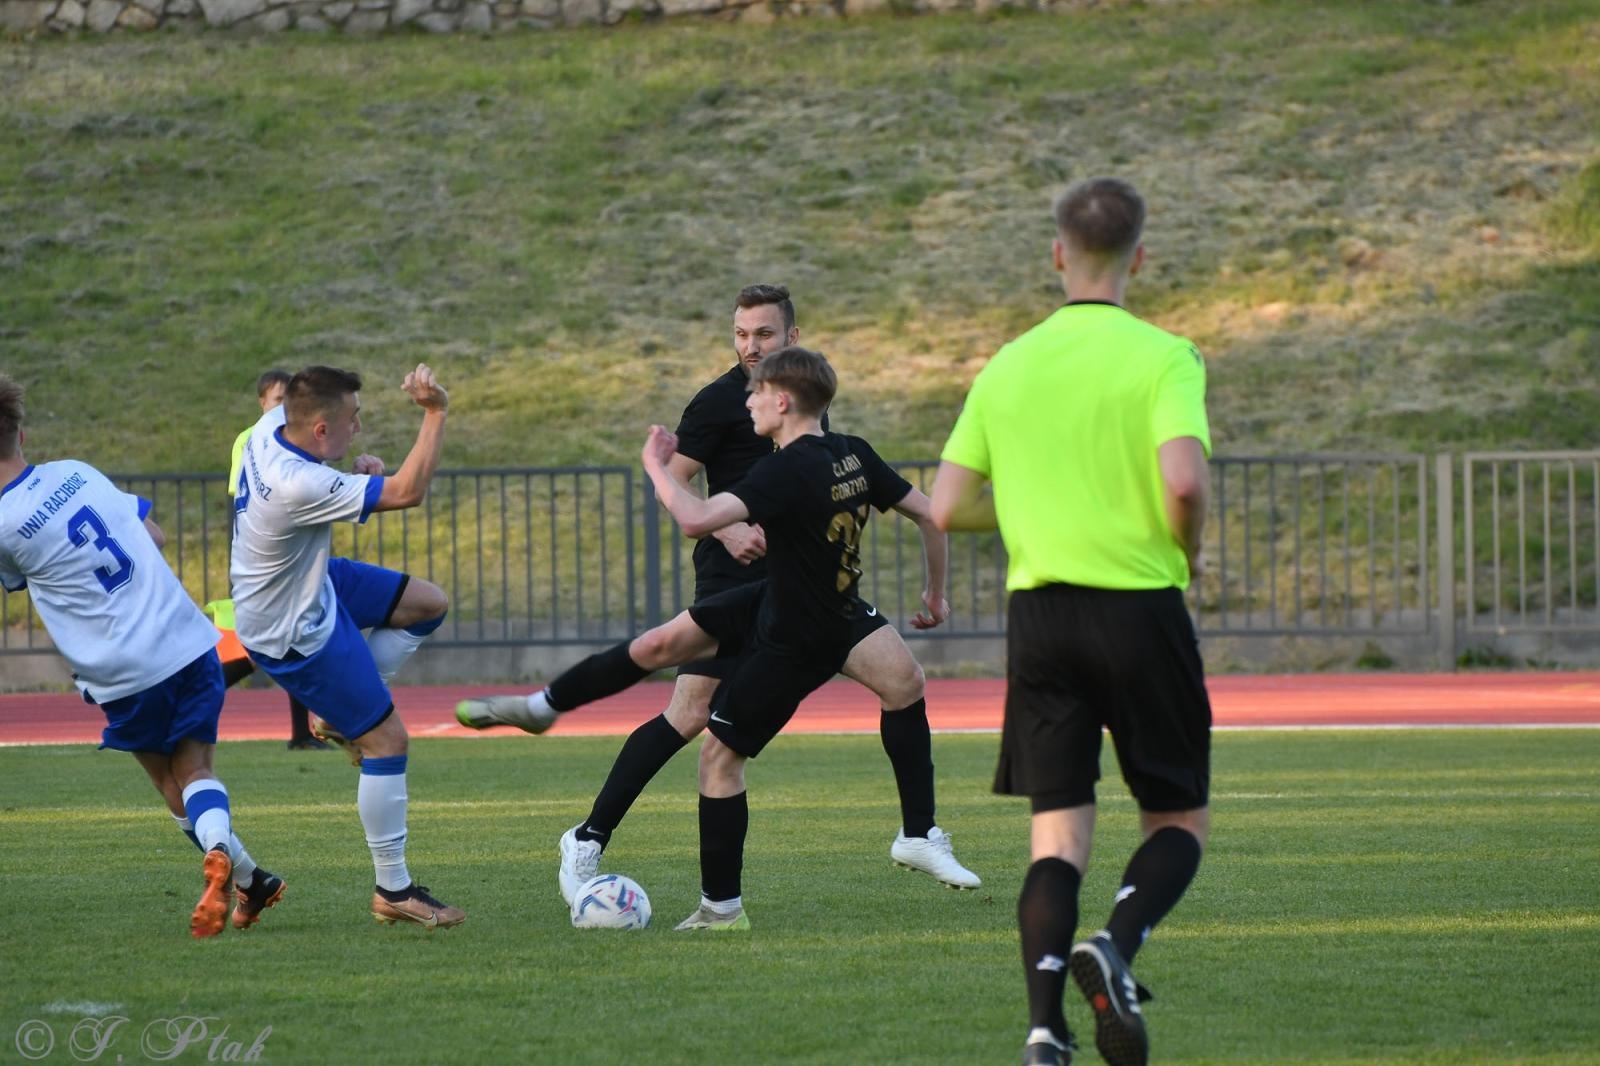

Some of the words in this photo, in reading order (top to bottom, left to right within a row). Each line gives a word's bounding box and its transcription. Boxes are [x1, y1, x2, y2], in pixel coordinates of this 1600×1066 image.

[17, 510, 50, 539] UNIA
[43, 472, 88, 515] RACIBÓRZ
[68, 504, 135, 595] 3
